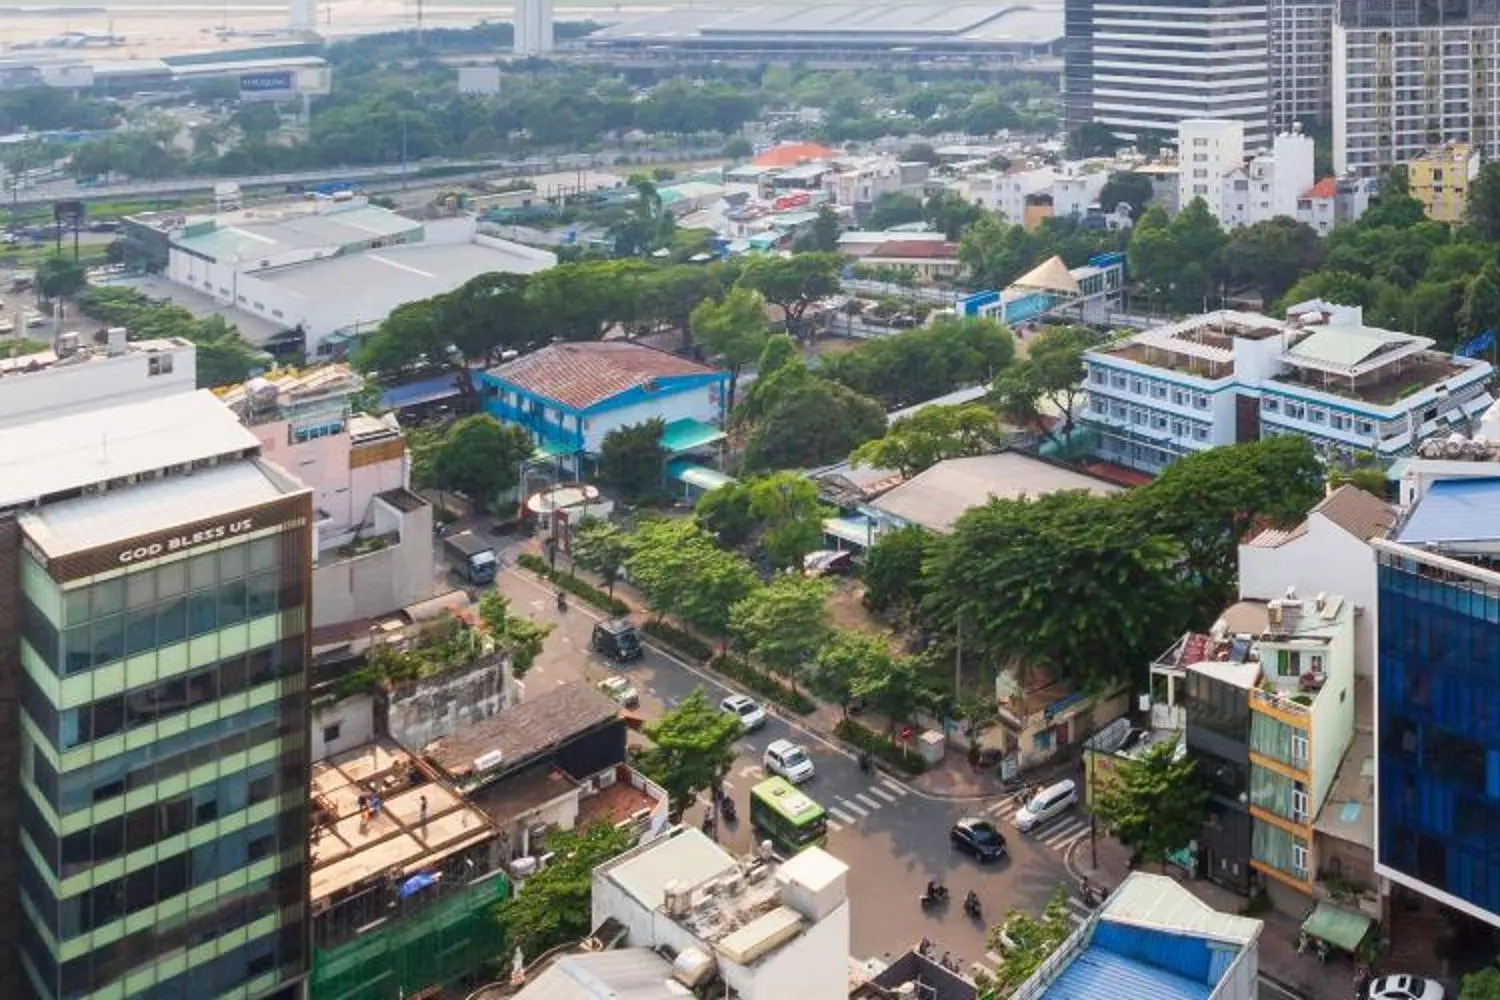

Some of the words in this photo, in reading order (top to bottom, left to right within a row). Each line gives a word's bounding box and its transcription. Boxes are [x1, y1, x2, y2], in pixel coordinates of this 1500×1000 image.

[118, 542, 163, 562] GOD
[167, 525, 225, 550] BLESS
[228, 518, 252, 534] US
